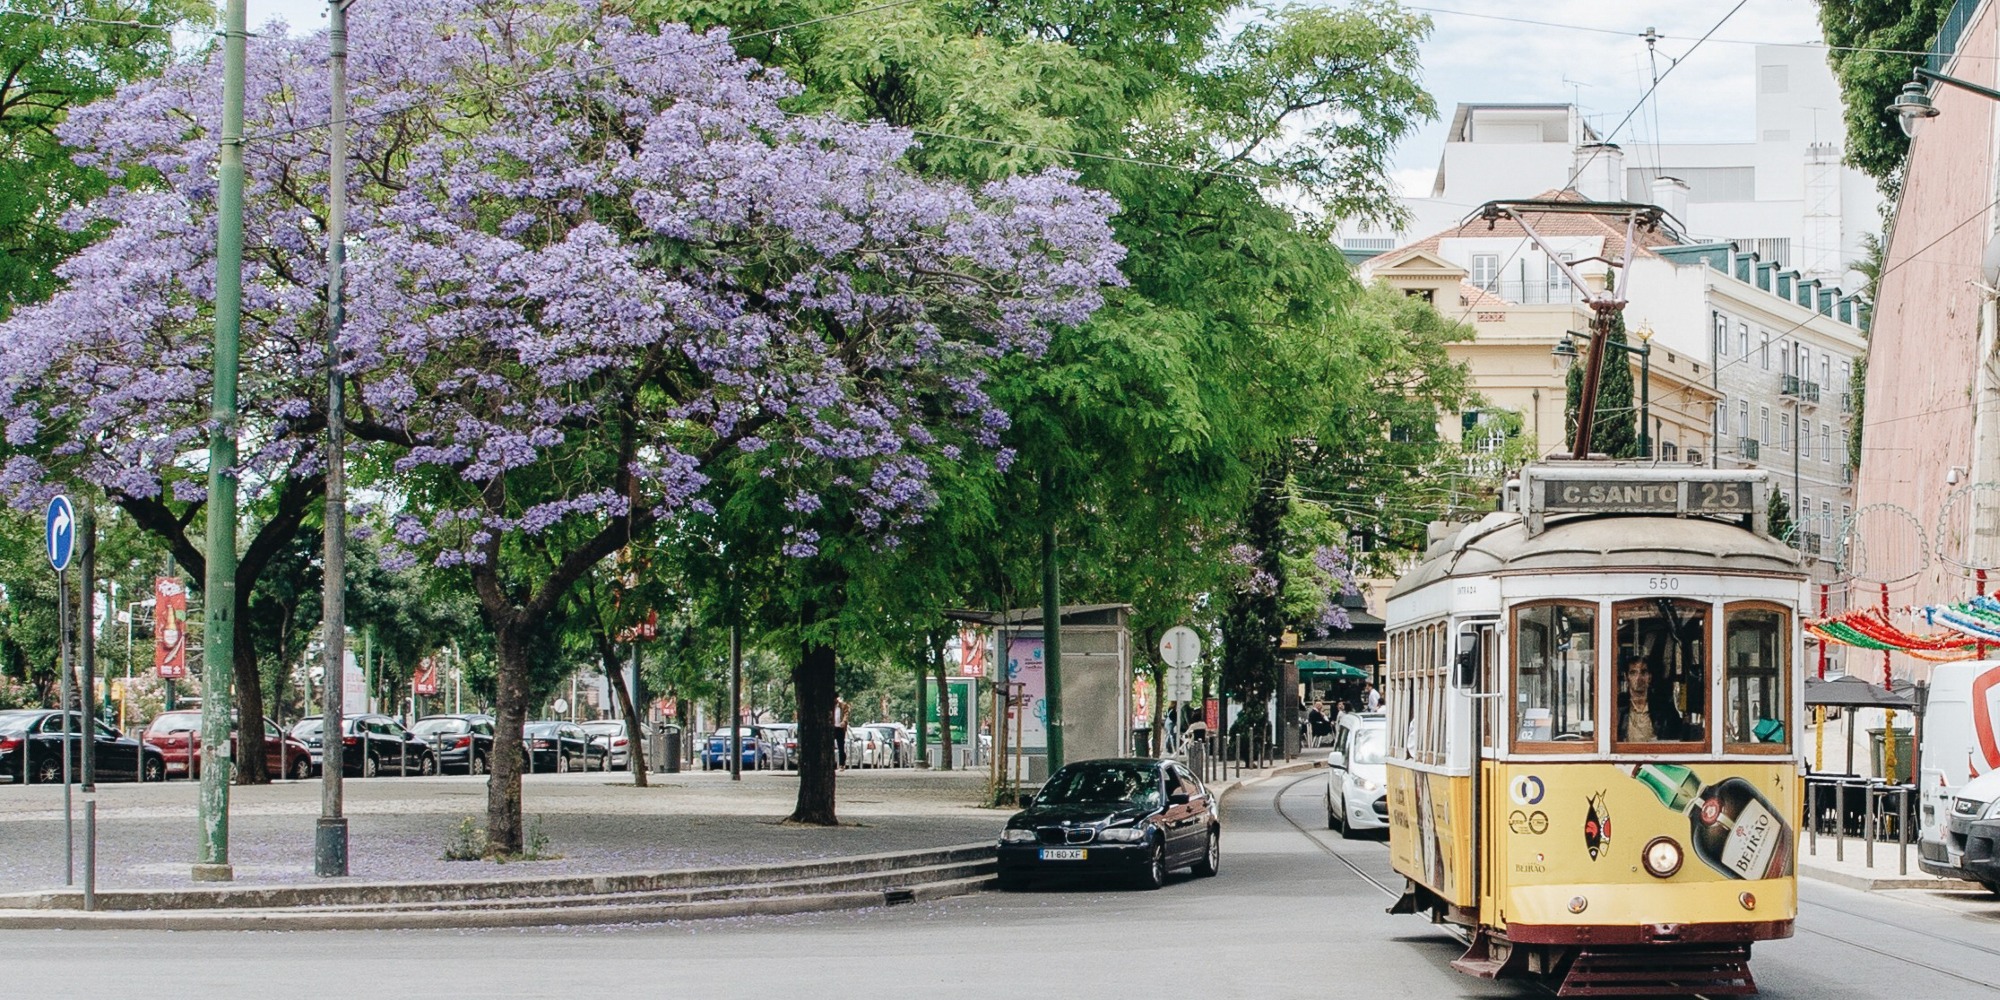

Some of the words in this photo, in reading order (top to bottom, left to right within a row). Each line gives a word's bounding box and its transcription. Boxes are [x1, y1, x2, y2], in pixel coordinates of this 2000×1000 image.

[1563, 485, 1677, 503] C.SANTO
[1701, 483, 1739, 508] 25
[1649, 577, 1679, 590] 550
[1521, 730, 1534, 740] 02
[1736, 814, 1769, 872] BEIRÃO
